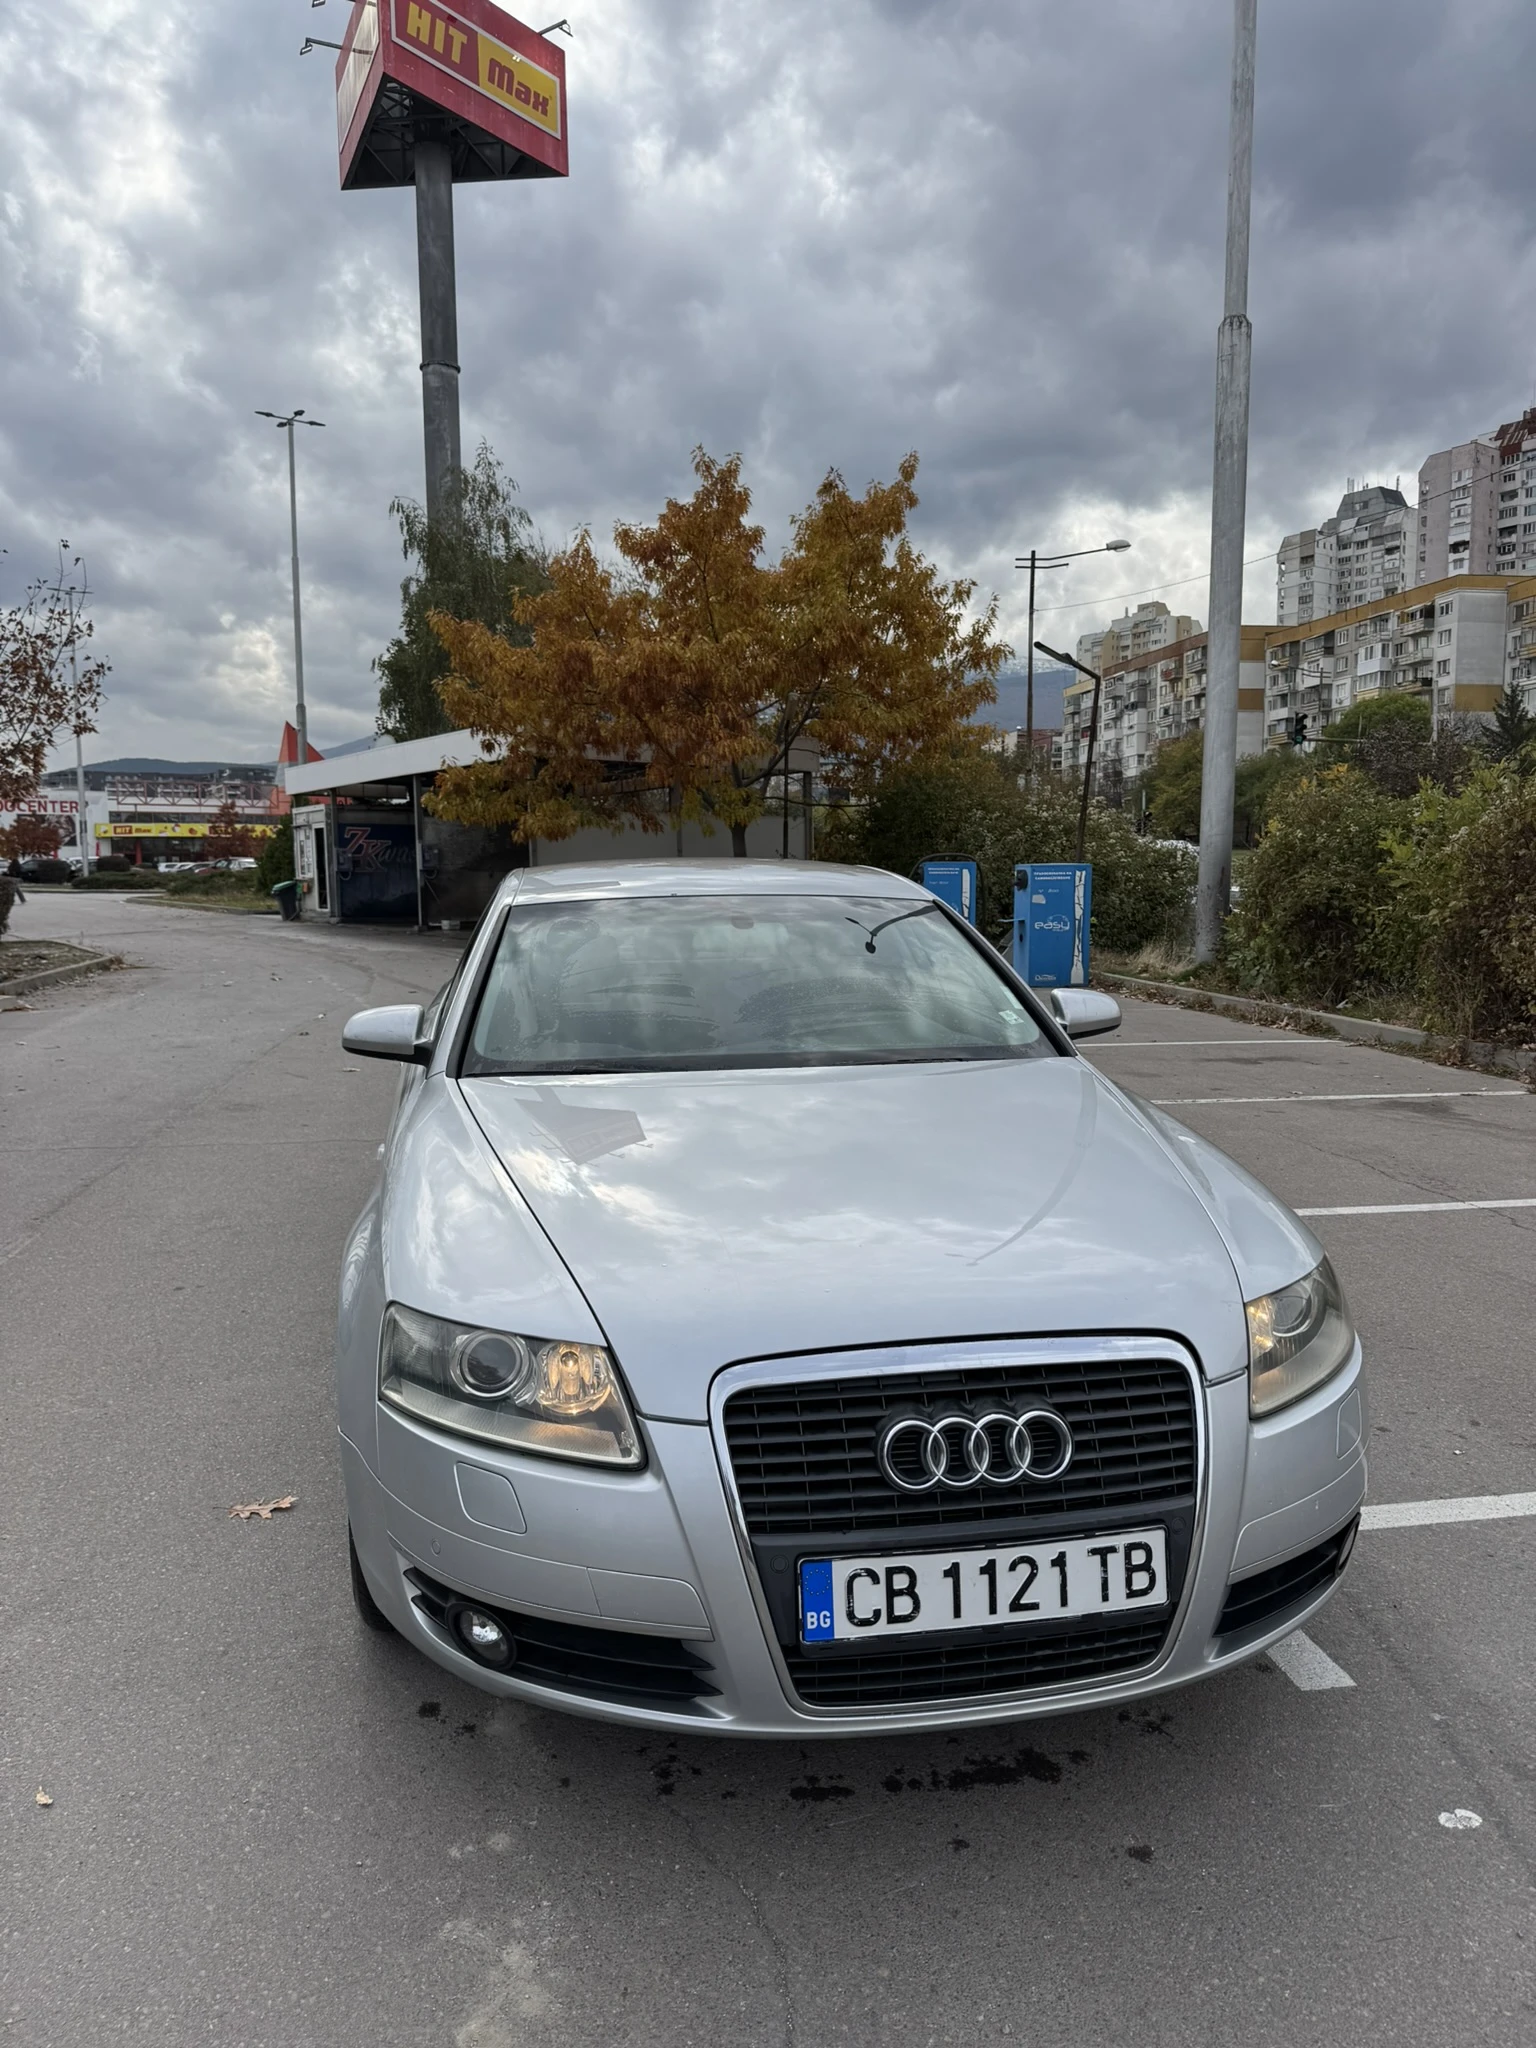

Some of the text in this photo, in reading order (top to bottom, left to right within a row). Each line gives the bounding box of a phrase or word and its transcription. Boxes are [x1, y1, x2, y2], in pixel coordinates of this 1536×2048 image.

[406, 1, 468, 65] HIT
[1034, 921, 1070, 931] easy
[845, 1541, 1157, 1627] CB 1121 TB
[806, 1611, 831, 1630] BG
